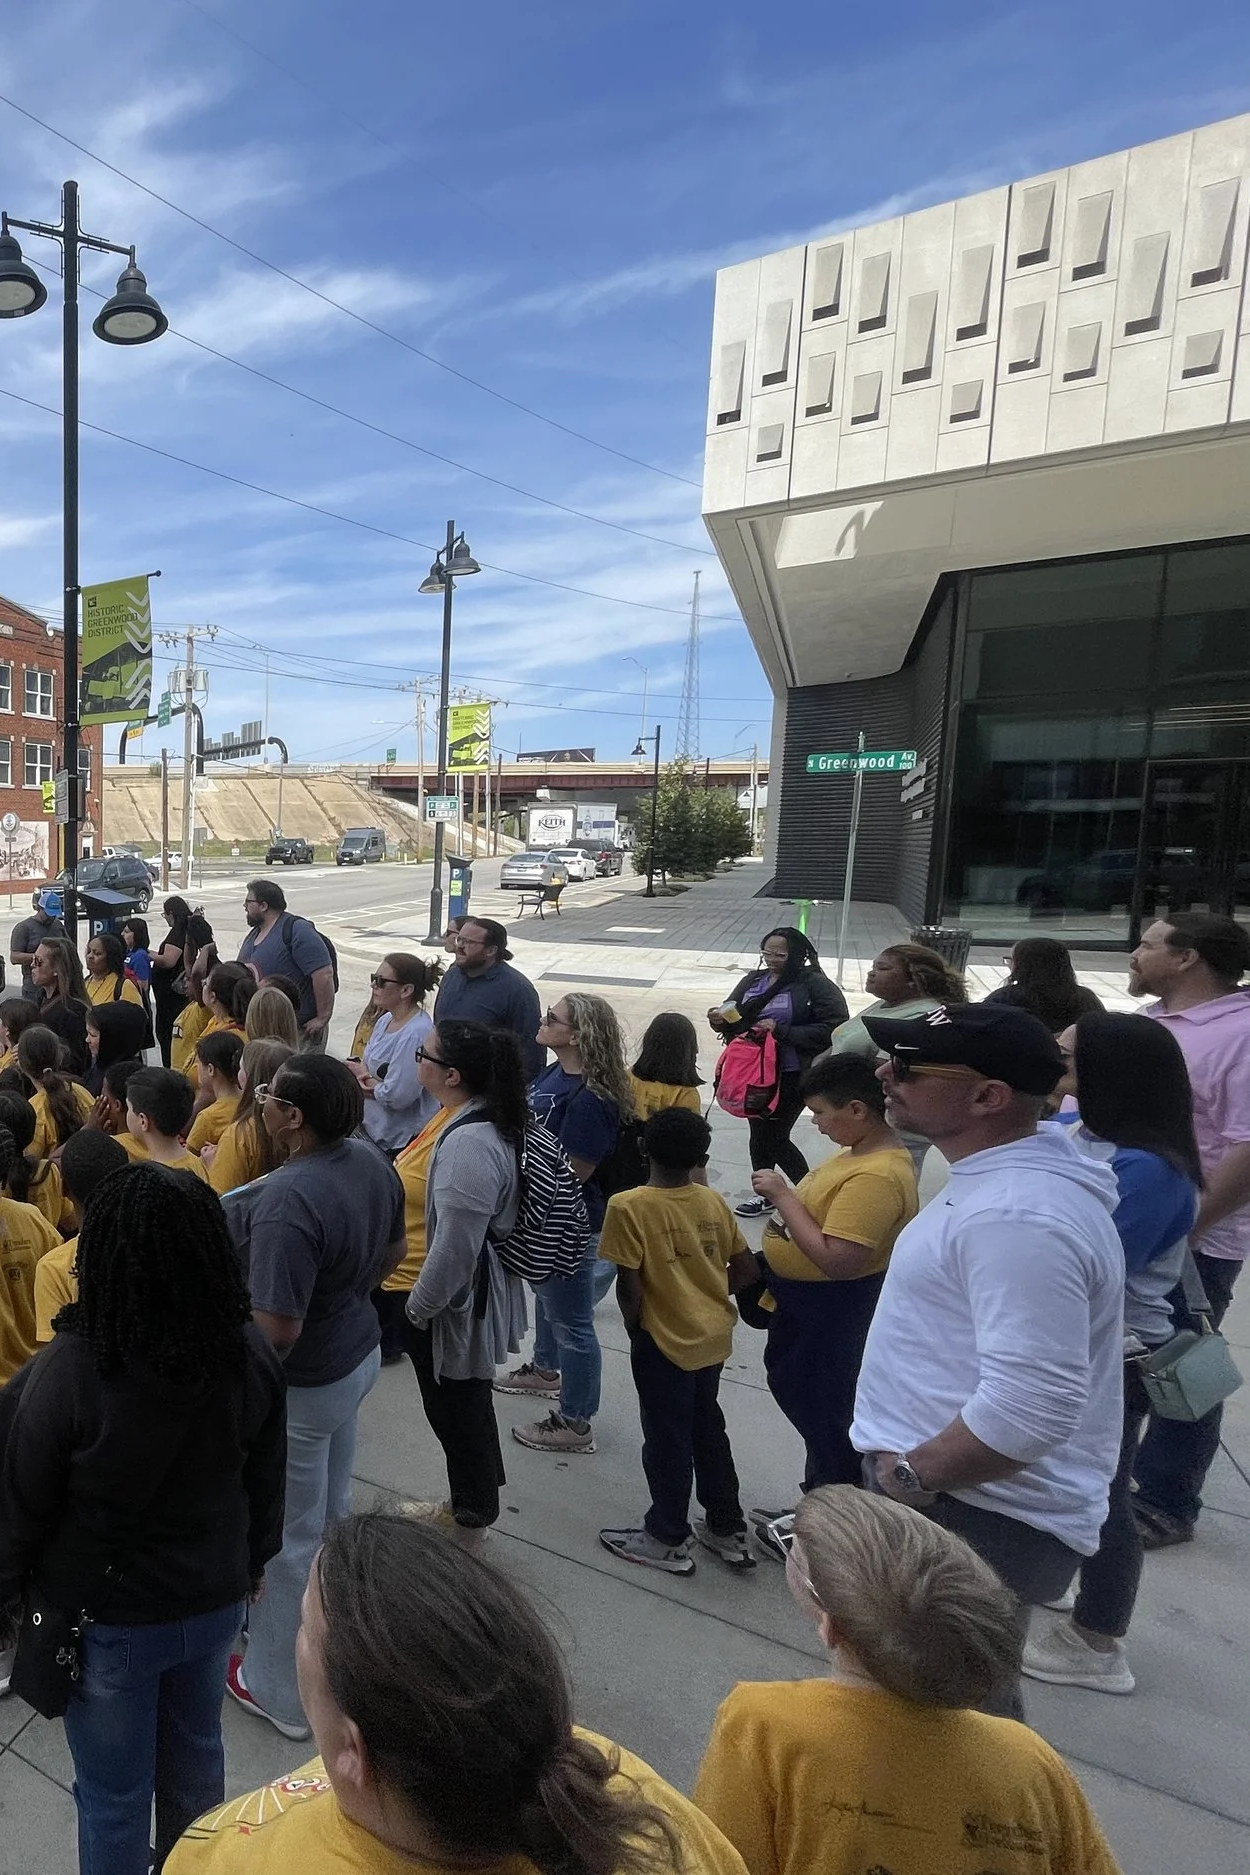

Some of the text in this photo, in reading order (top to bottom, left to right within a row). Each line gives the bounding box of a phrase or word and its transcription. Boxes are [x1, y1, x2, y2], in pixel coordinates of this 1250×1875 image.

[88, 604, 124, 618] HISTORIC
[88, 612, 138, 628] GREENWOOD
[88, 625, 124, 637] DISTRICT
[819, 754, 895, 770] Greenwood
[538, 818, 566, 827] KEITH
[453, 868, 460, 878] P
[93, 920, 104, 936] P
